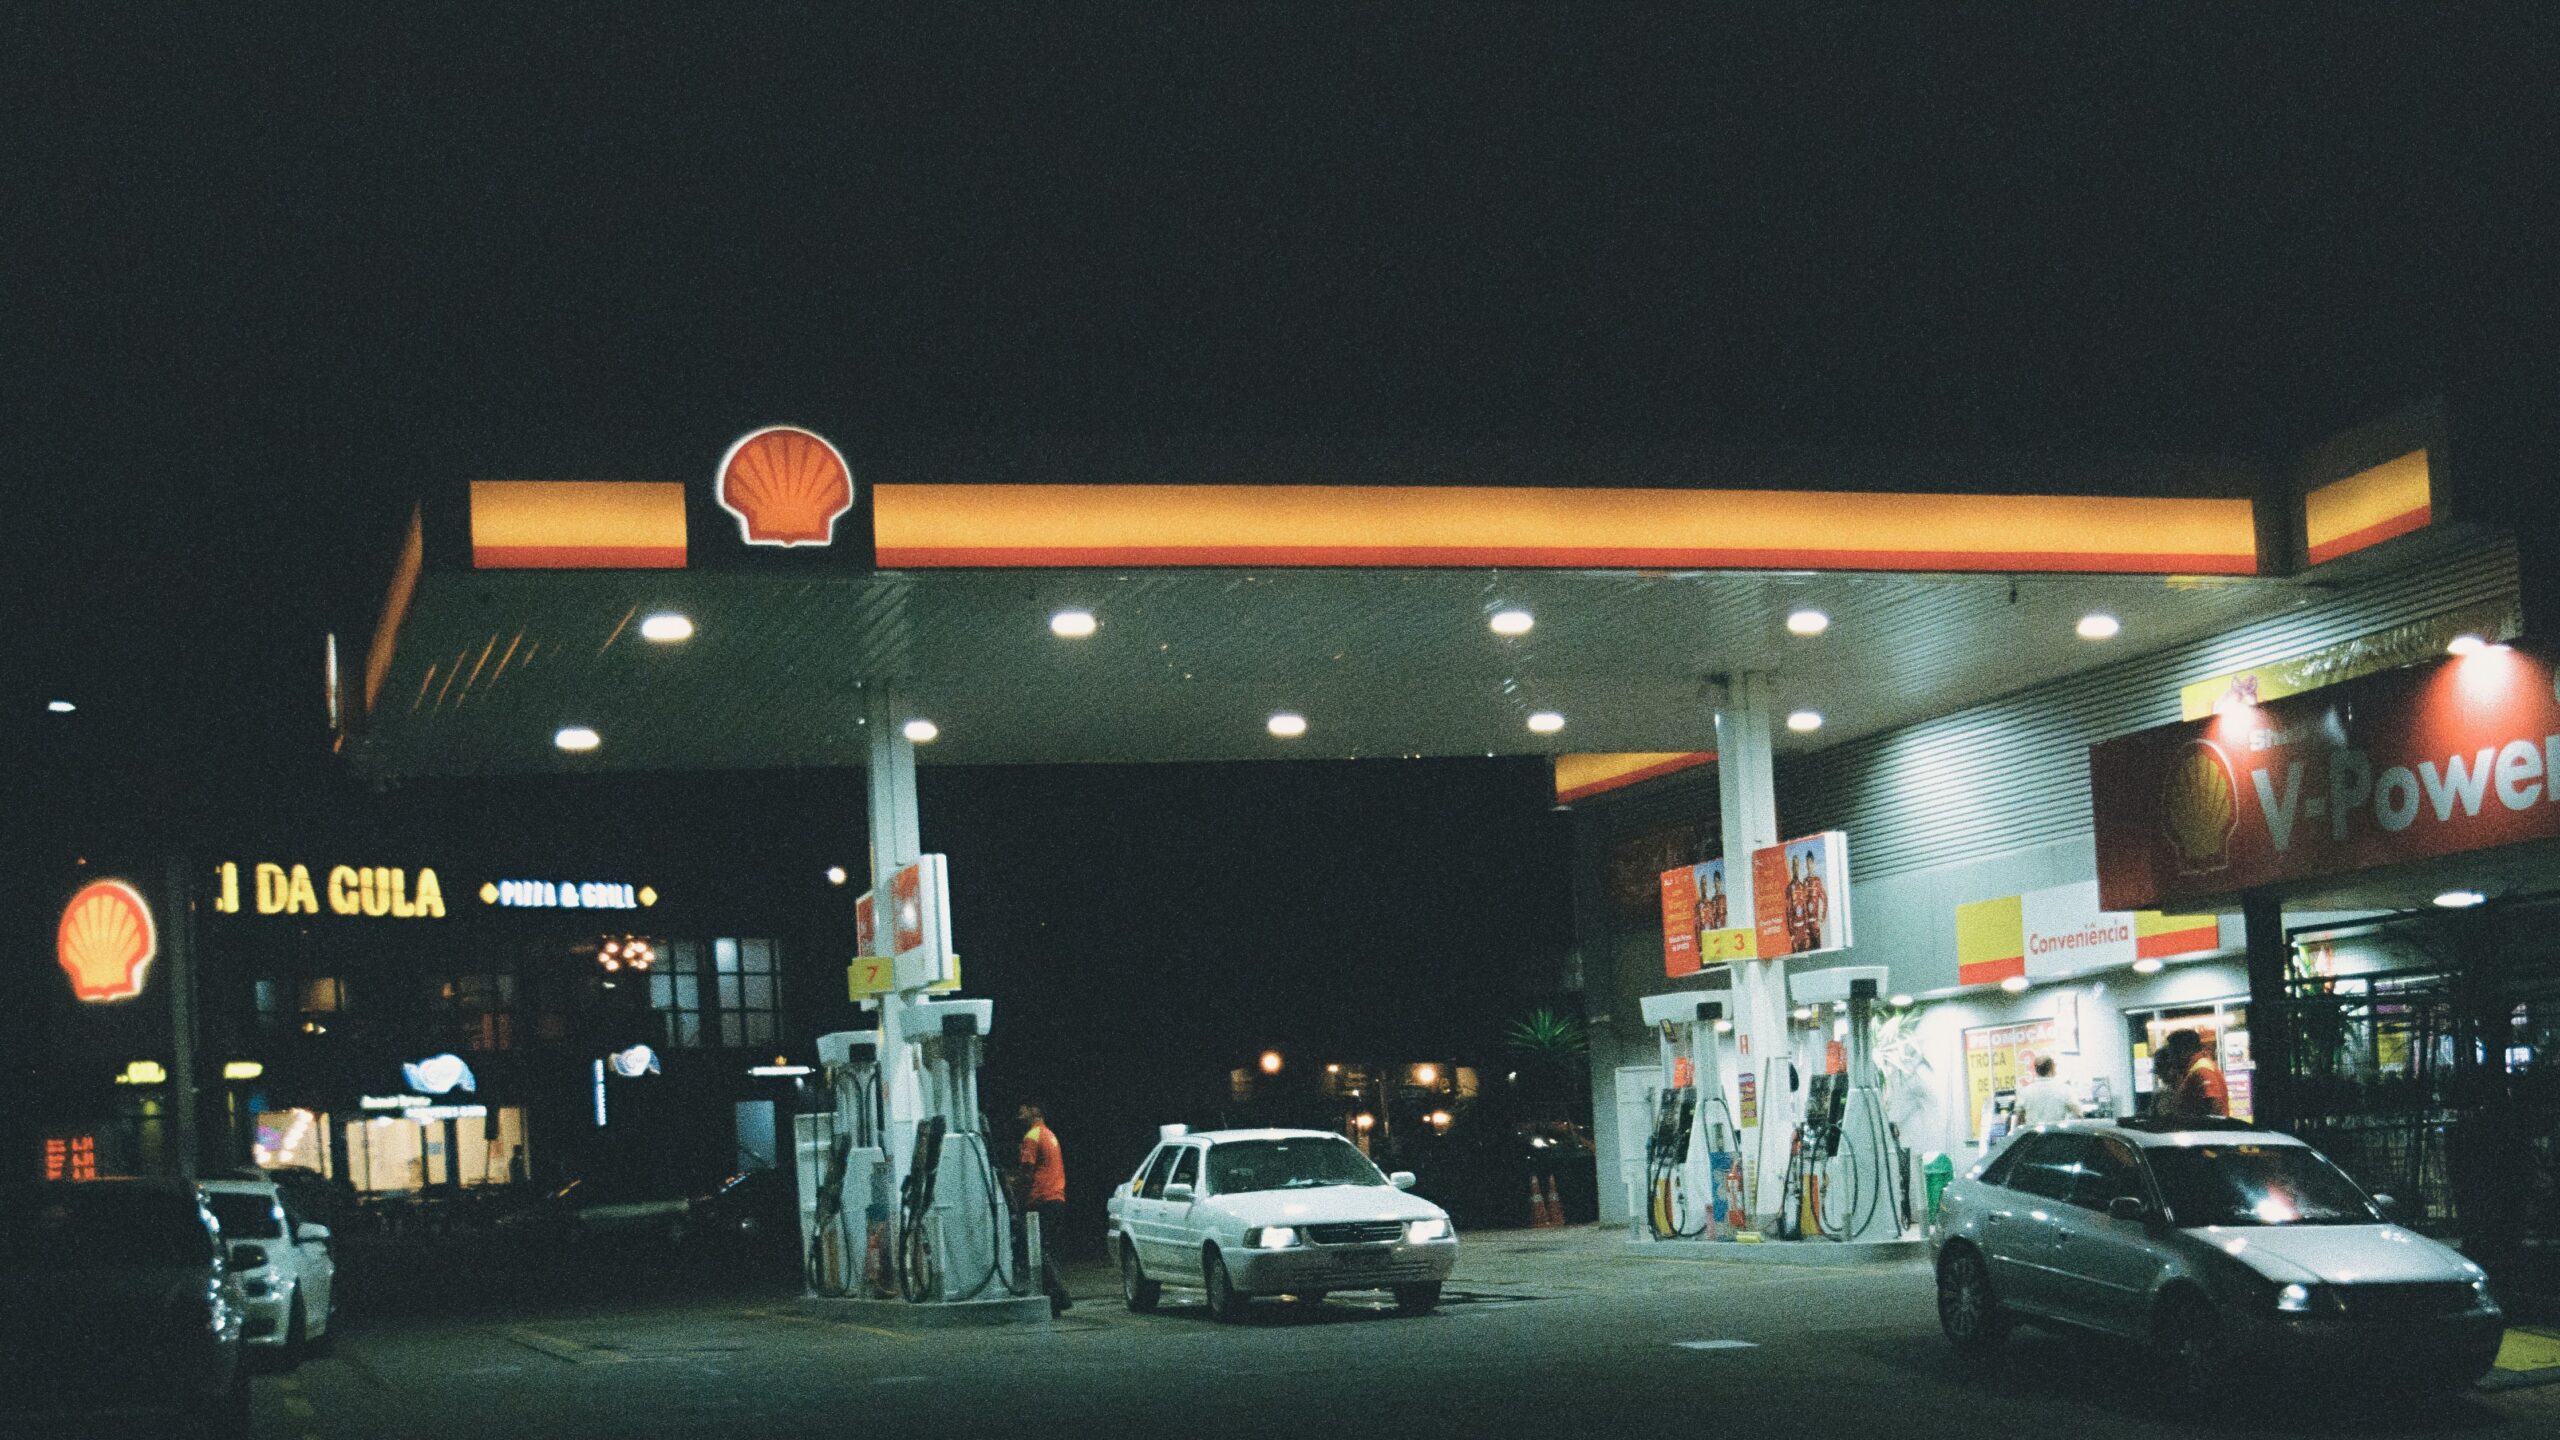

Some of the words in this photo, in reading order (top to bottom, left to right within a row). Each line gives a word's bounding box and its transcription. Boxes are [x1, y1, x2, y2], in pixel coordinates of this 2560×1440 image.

[215, 861, 240, 914] I
[256, 862, 319, 914] DA
[328, 864, 446, 918] GULA
[560, 880, 580, 908] &
[1733, 932, 1746, 951] 3
[2029, 920, 2129, 954] Conveniência
[866, 964, 879, 985] 7
[1969, 1051, 2008, 1070] TROCA
